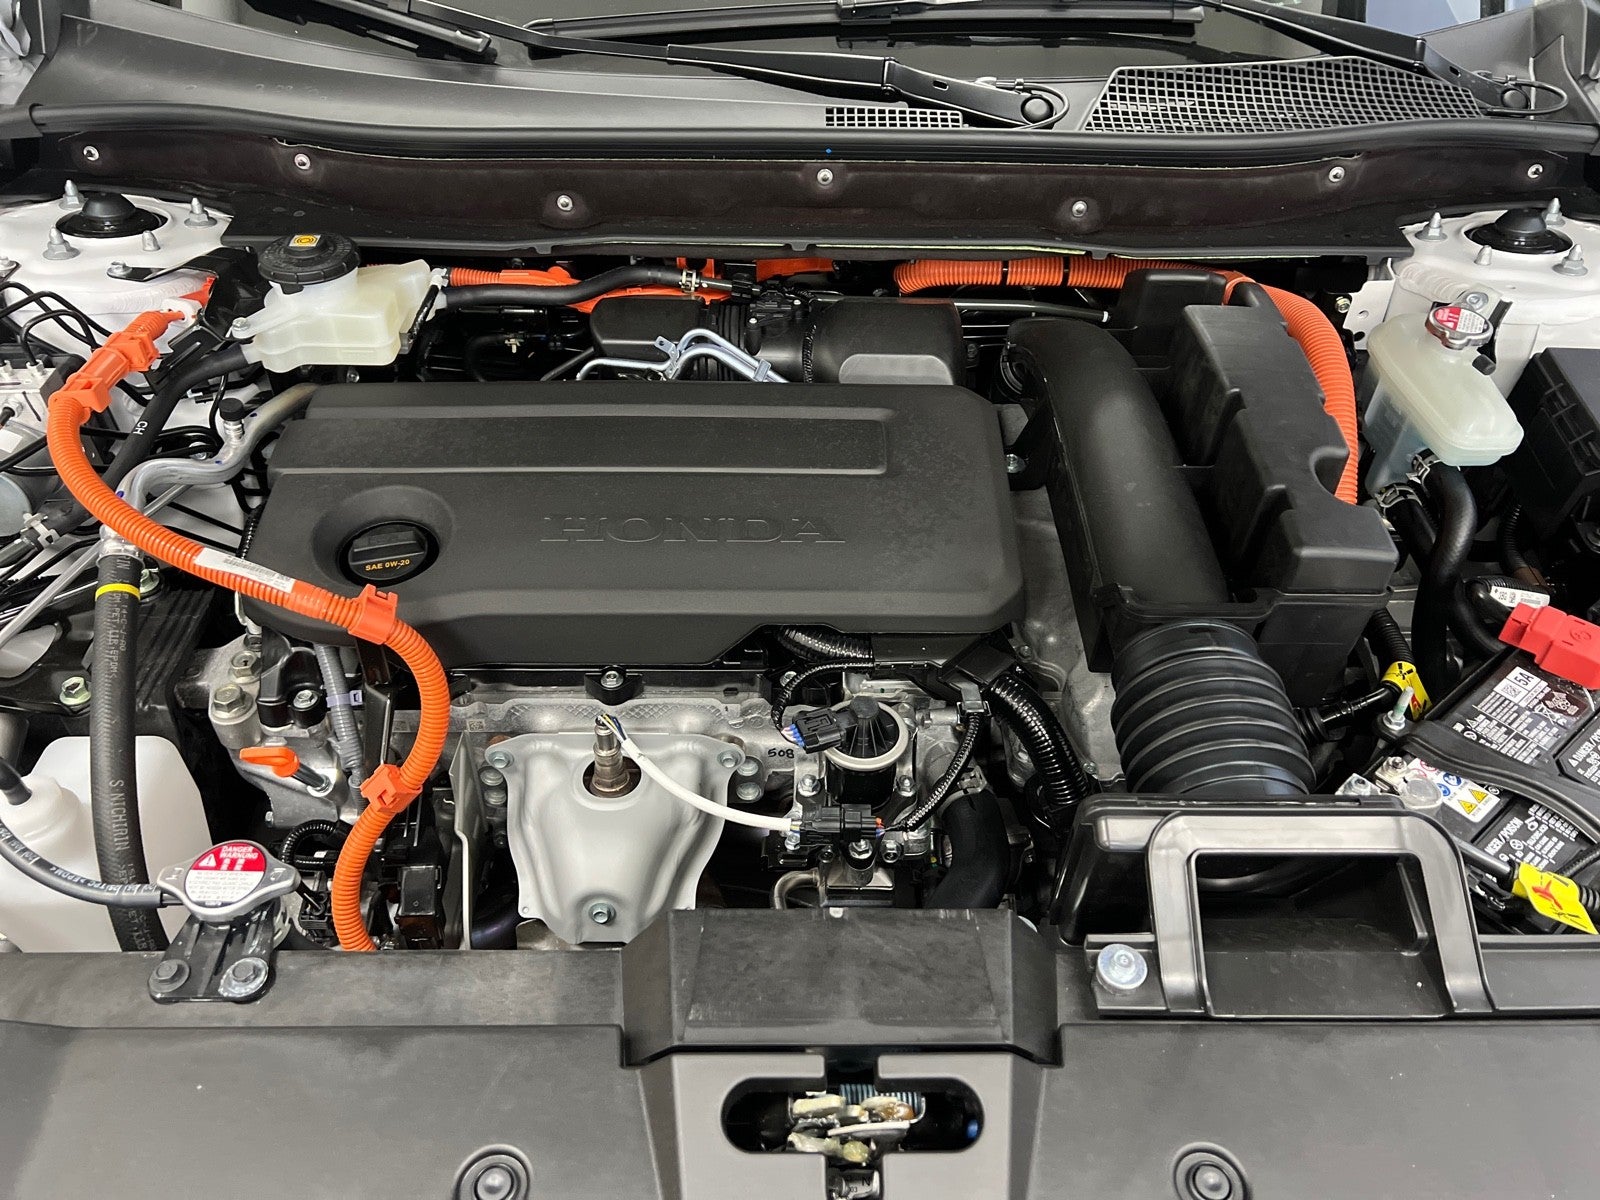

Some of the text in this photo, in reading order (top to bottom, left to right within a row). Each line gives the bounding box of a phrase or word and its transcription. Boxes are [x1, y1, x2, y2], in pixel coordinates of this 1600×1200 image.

[540, 517, 845, 543] HONDA
[365, 559, 410, 571] SAE 0W-20
[1514, 672, 1534, 686] 5A
[768, 748, 795, 759] 508
[111, 793, 130, 850] NICHIRIN
[221, 845, 255, 854] DANGER
[219, 852, 259, 860] WARNUNG
